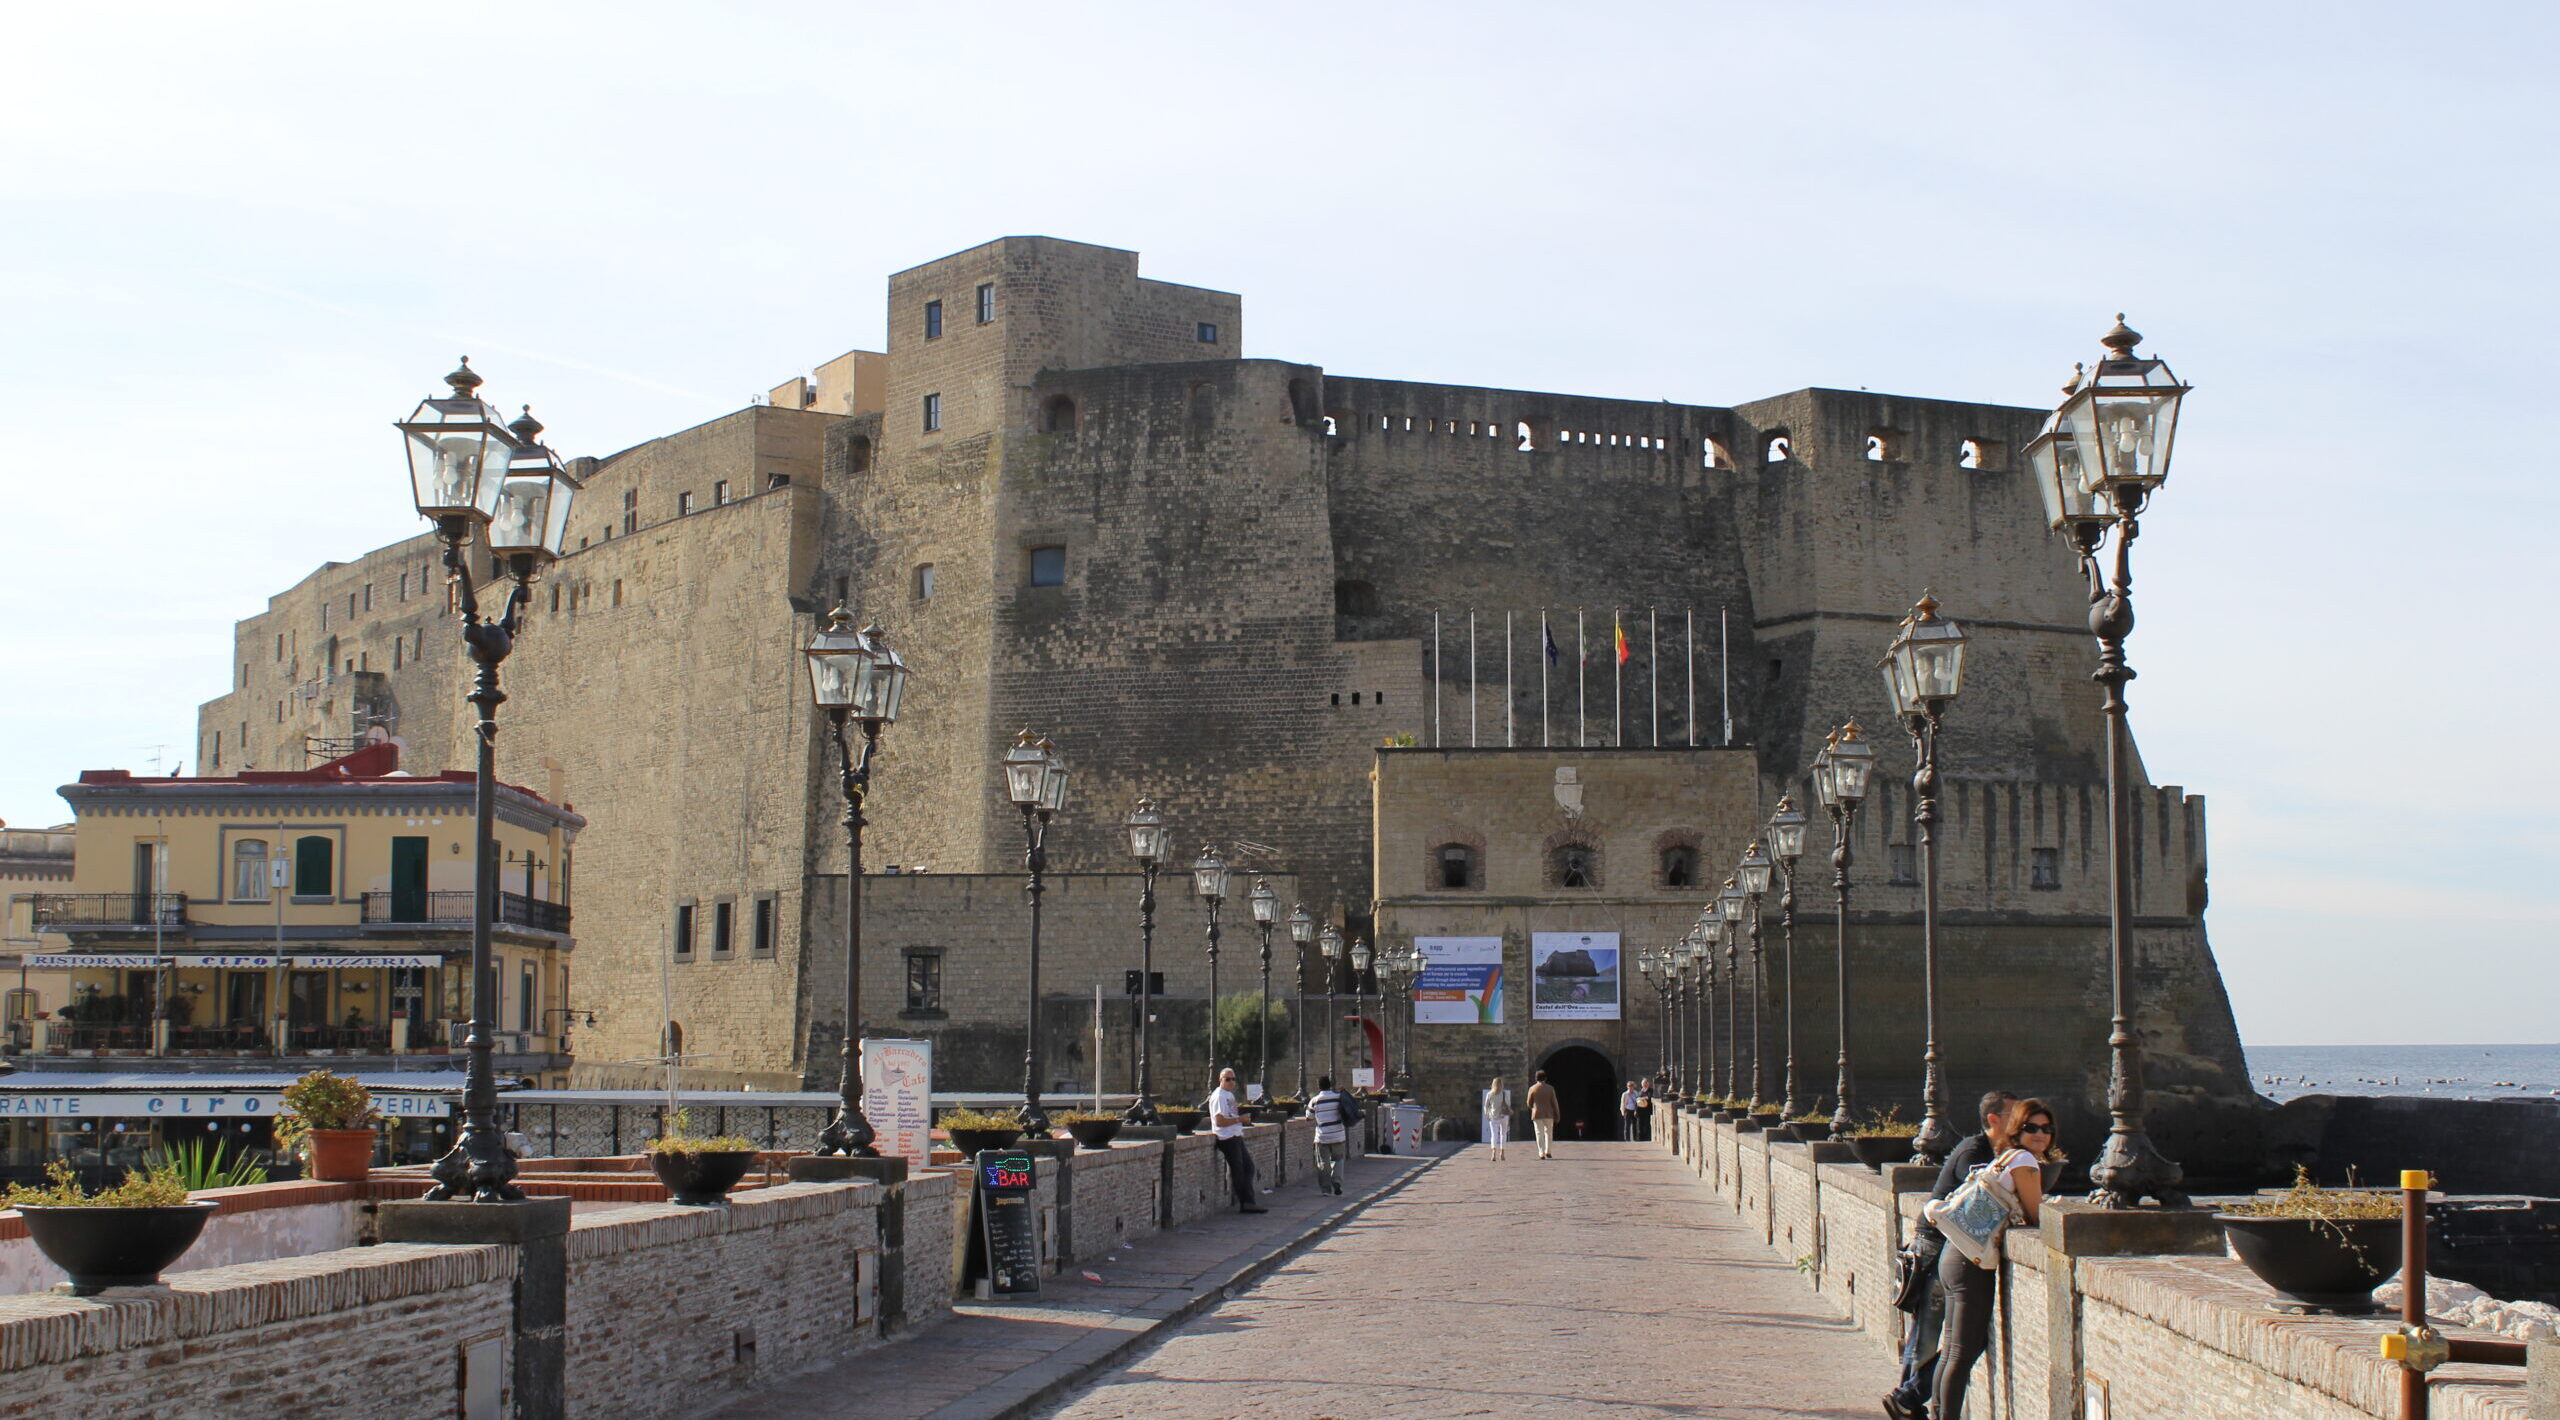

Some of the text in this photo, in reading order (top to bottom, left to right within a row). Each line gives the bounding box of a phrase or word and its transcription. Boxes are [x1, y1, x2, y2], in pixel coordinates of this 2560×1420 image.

[201, 956, 268, 966] ciro
[311, 957, 422, 966] PIZZERIA
[0, 1098, 437, 1114] RANTE ciro ZERIA
[998, 1169, 1030, 1187] BAR
